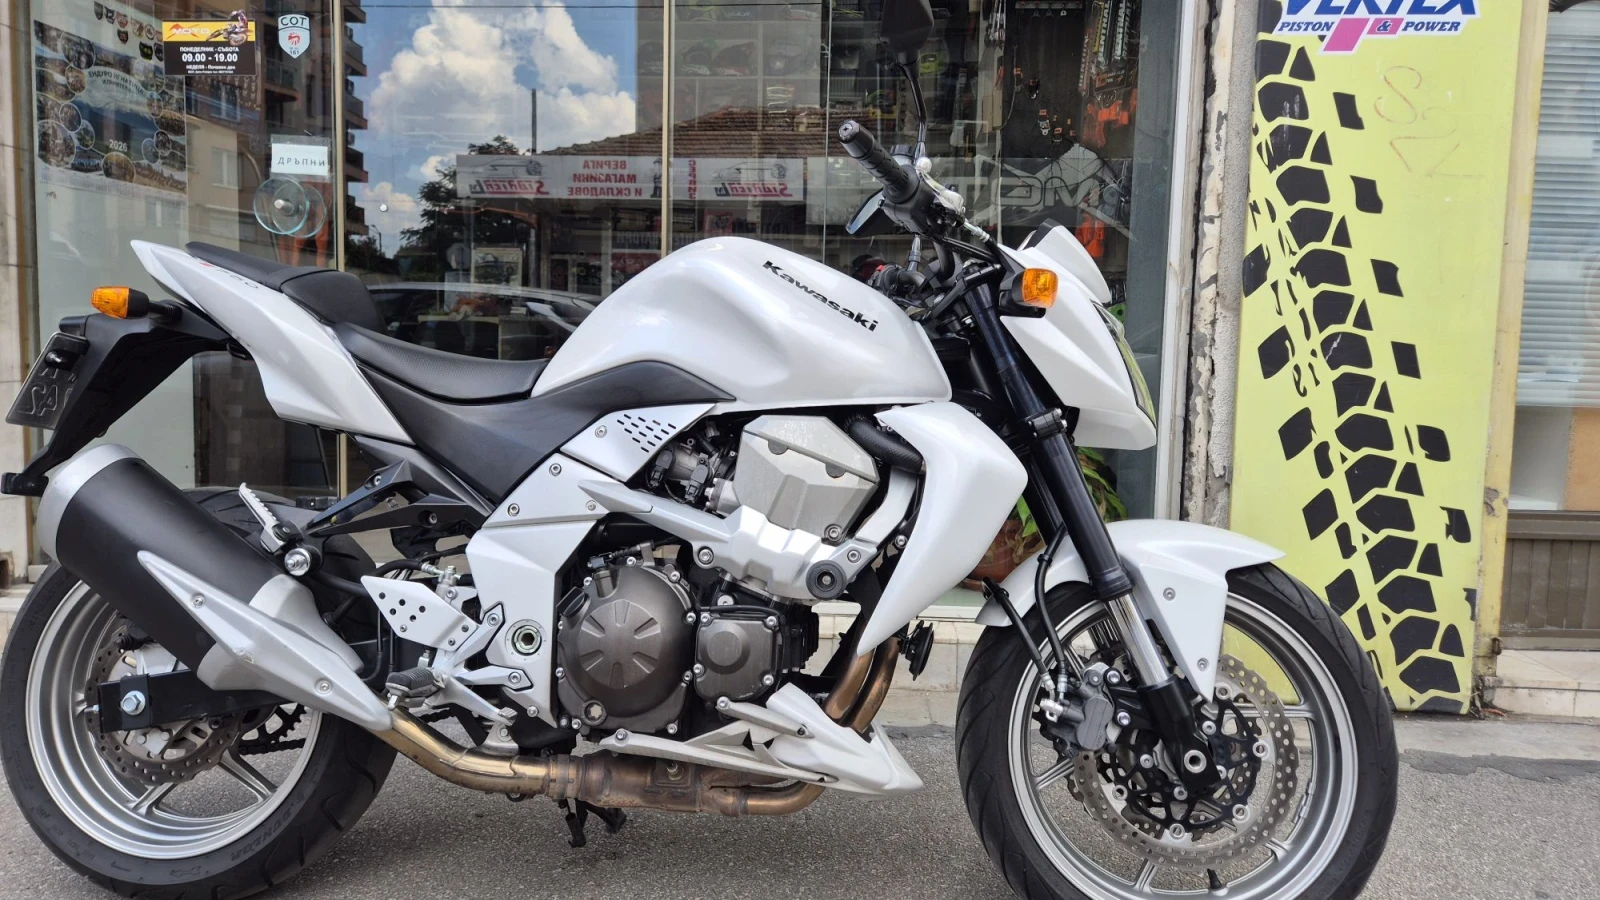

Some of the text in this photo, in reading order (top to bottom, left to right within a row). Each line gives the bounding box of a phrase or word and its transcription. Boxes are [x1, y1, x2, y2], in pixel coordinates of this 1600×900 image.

[280, 16, 307, 26] СОТ
[1278, 20, 1461, 33] PISTON & POWER
[182, 53, 206, 62] 09.00
[214, 53, 238, 62] 19.00
[109, 139, 128, 152] 2026
[277, 157, 325, 167] ДРЪПНИ
[763, 260, 879, 332] Kawasaki
